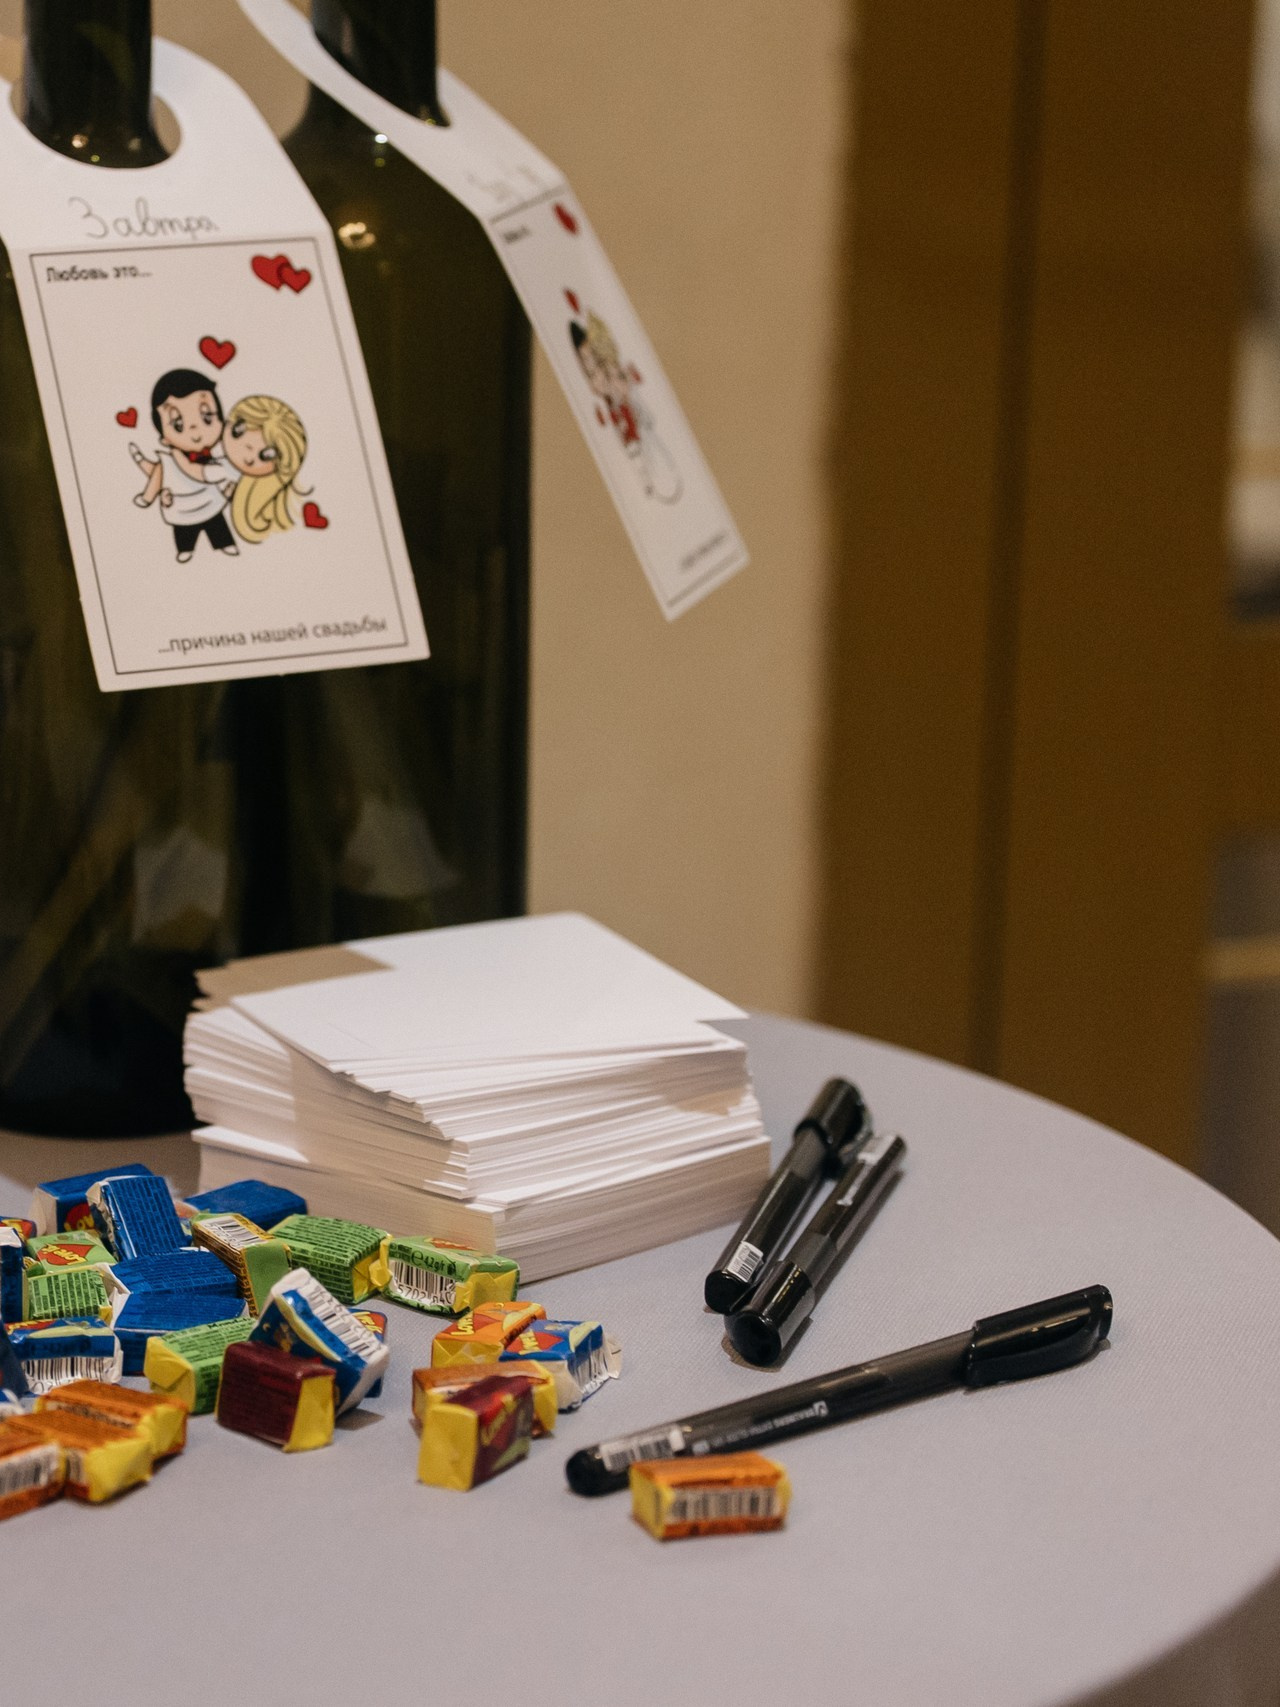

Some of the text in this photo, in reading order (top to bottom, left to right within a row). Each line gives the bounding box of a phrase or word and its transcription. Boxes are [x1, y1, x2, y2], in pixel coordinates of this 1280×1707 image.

[46, 265, 109, 283] Любовь
[250, 622, 309, 644] нашей
[312, 615, 388, 639] свадьбы
[53, 1248, 88, 1266] Love
